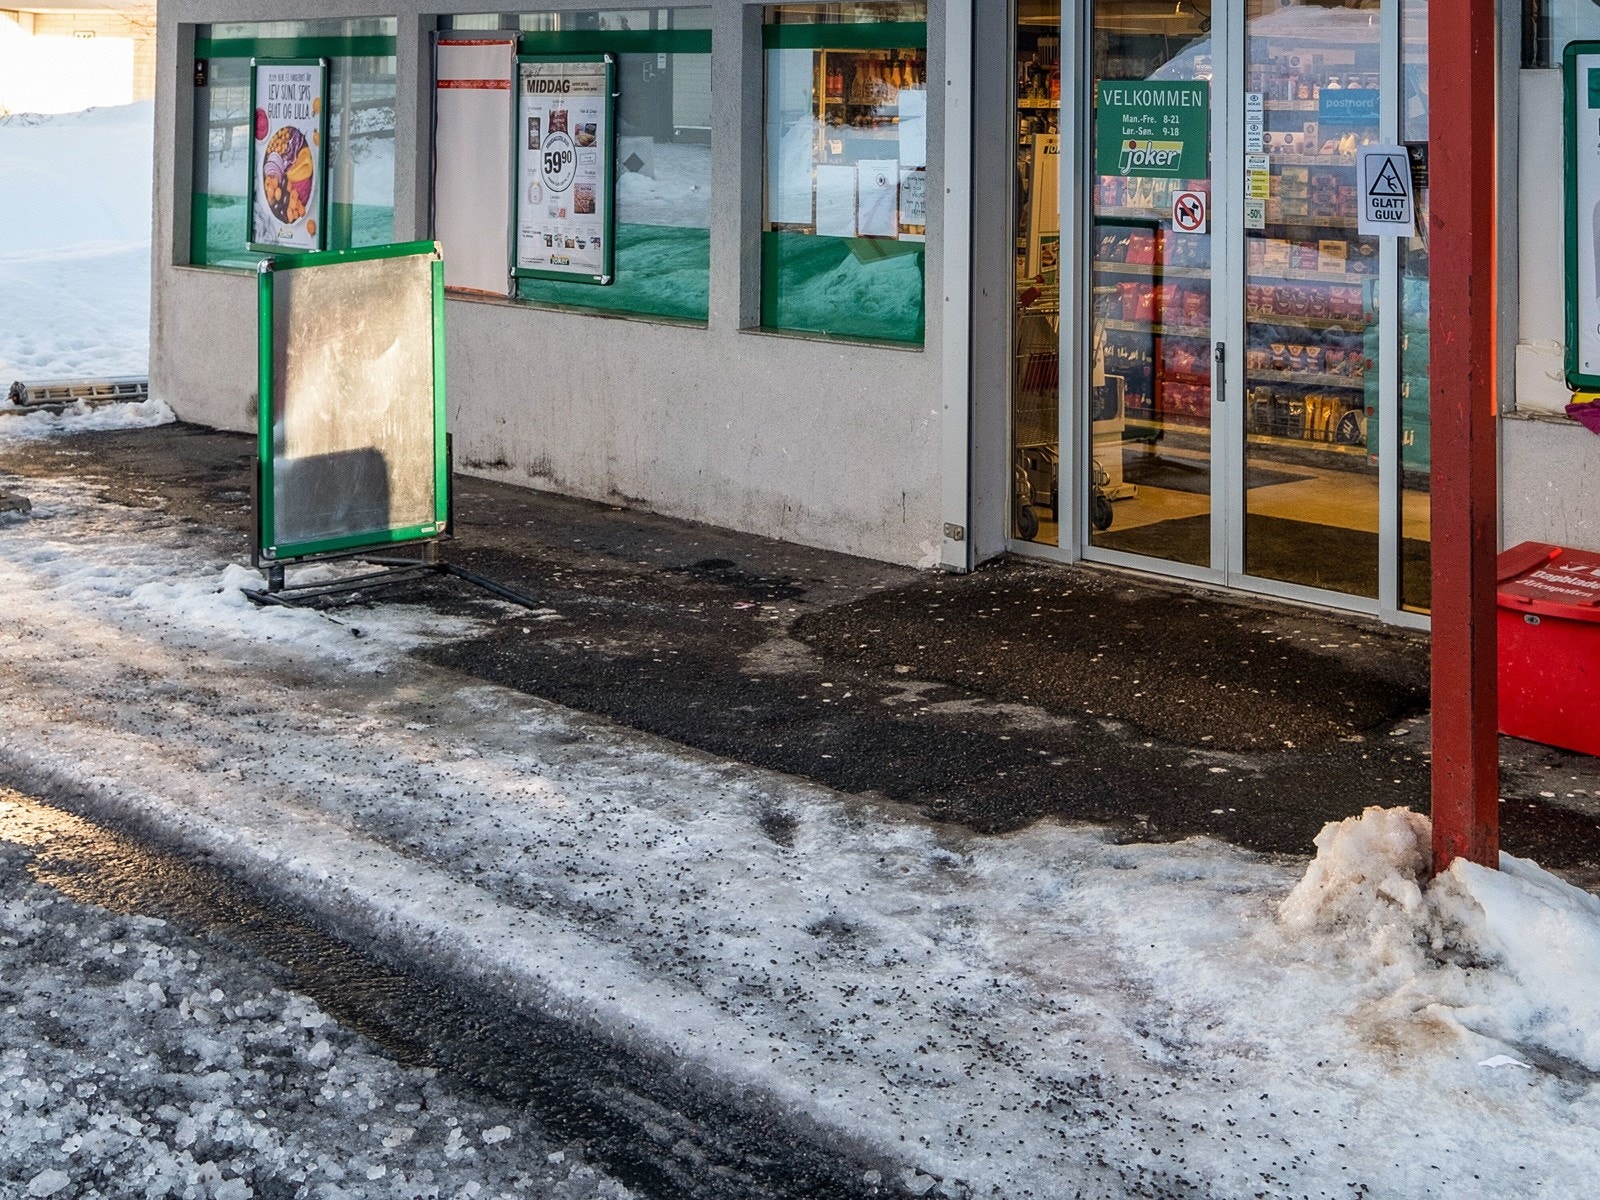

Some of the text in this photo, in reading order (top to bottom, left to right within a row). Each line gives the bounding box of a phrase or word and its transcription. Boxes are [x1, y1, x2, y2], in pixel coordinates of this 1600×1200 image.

[527, 79, 570, 94] MIDDAG
[1102, 89, 1203, 107] VELKOMMEN
[1163, 114, 1180, 124] 8-21
[1162, 127, 1180, 136] 9-18
[1120, 139, 1178, 175] joker
[1371, 198, 1406, 209] GLATT
[1374, 210, 1403, 220] GULV
